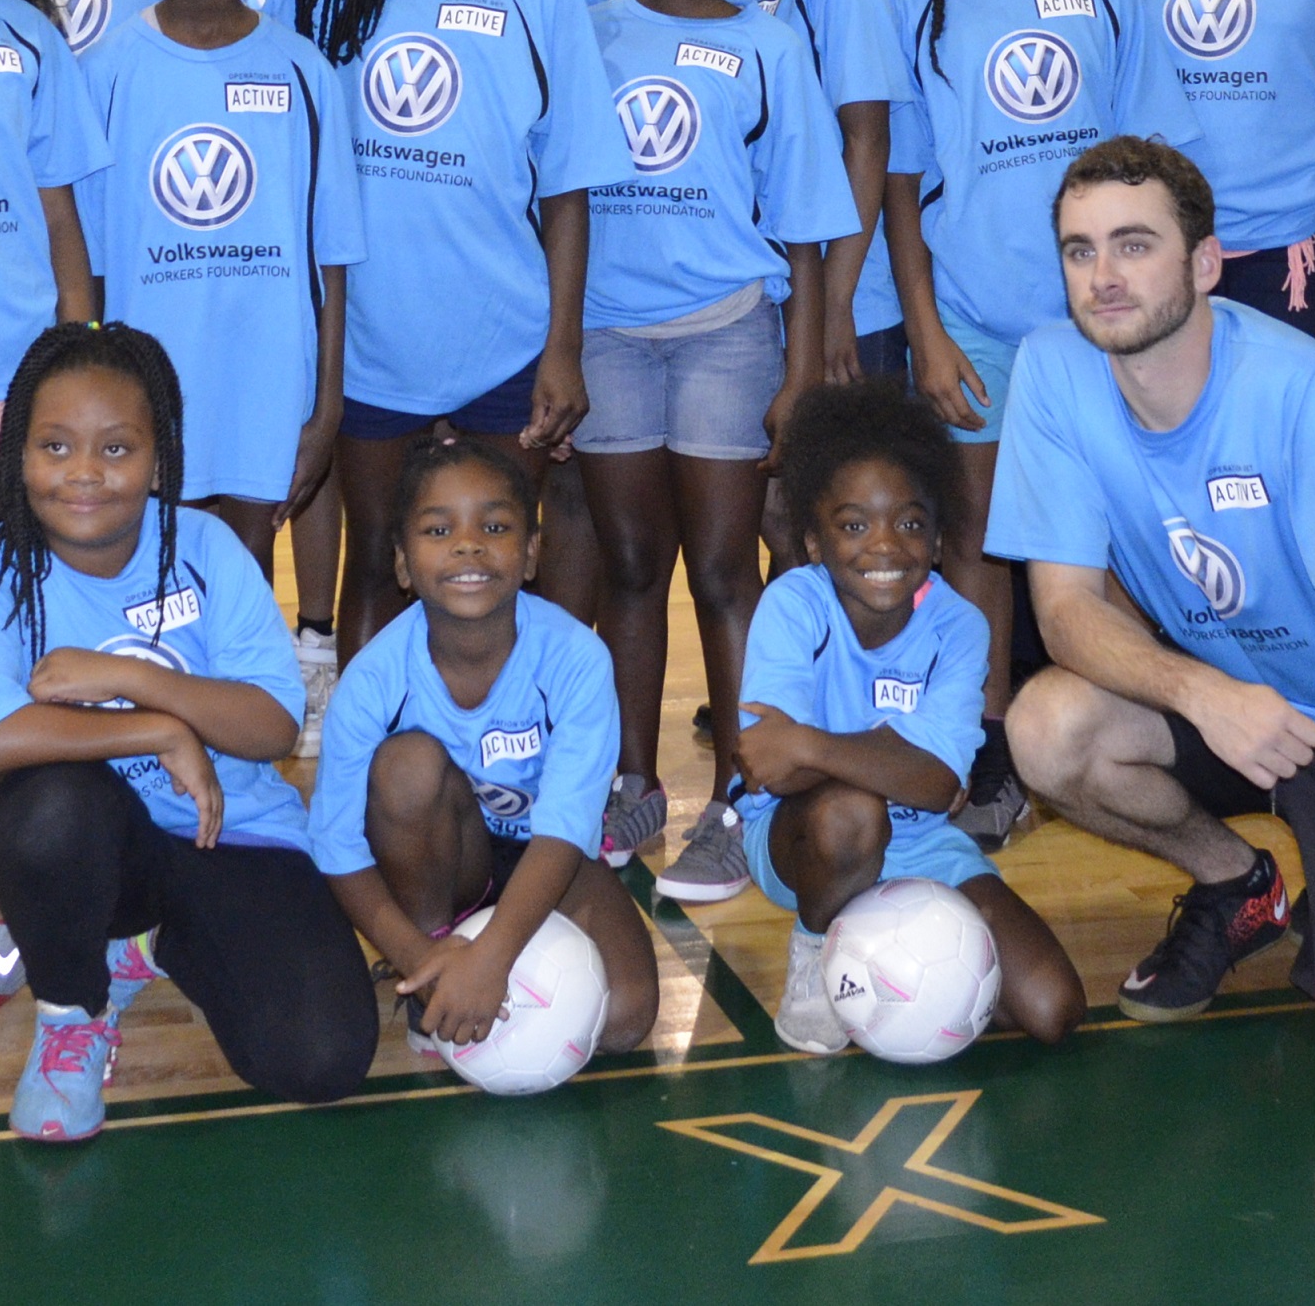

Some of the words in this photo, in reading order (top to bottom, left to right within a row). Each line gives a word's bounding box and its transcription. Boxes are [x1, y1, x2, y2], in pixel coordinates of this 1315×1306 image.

[443, 8, 501, 31] ACTIVE
[680, 48, 736, 73] ACTIVE
[1176, 68, 1269, 88] lkswagen
[232, 89, 286, 107] ACTIVE
[1199, 90, 1276, 102] FOUNDATION
[981, 127, 1099, 155] Volkswagen
[978, 153, 1037, 175] WORKERS
[390, 167, 473, 187] FOUNDATION
[635, 204, 716, 219] FOUNDATION
[147, 242, 282, 264] Volkswagen
[140, 266, 203, 286] WORKERS
[207, 265, 290, 278] FOUNDATION
[136, 593, 197, 631] ACIVE
[880, 683, 920, 706] ACTI
[485, 731, 538, 761] ACTIVE
